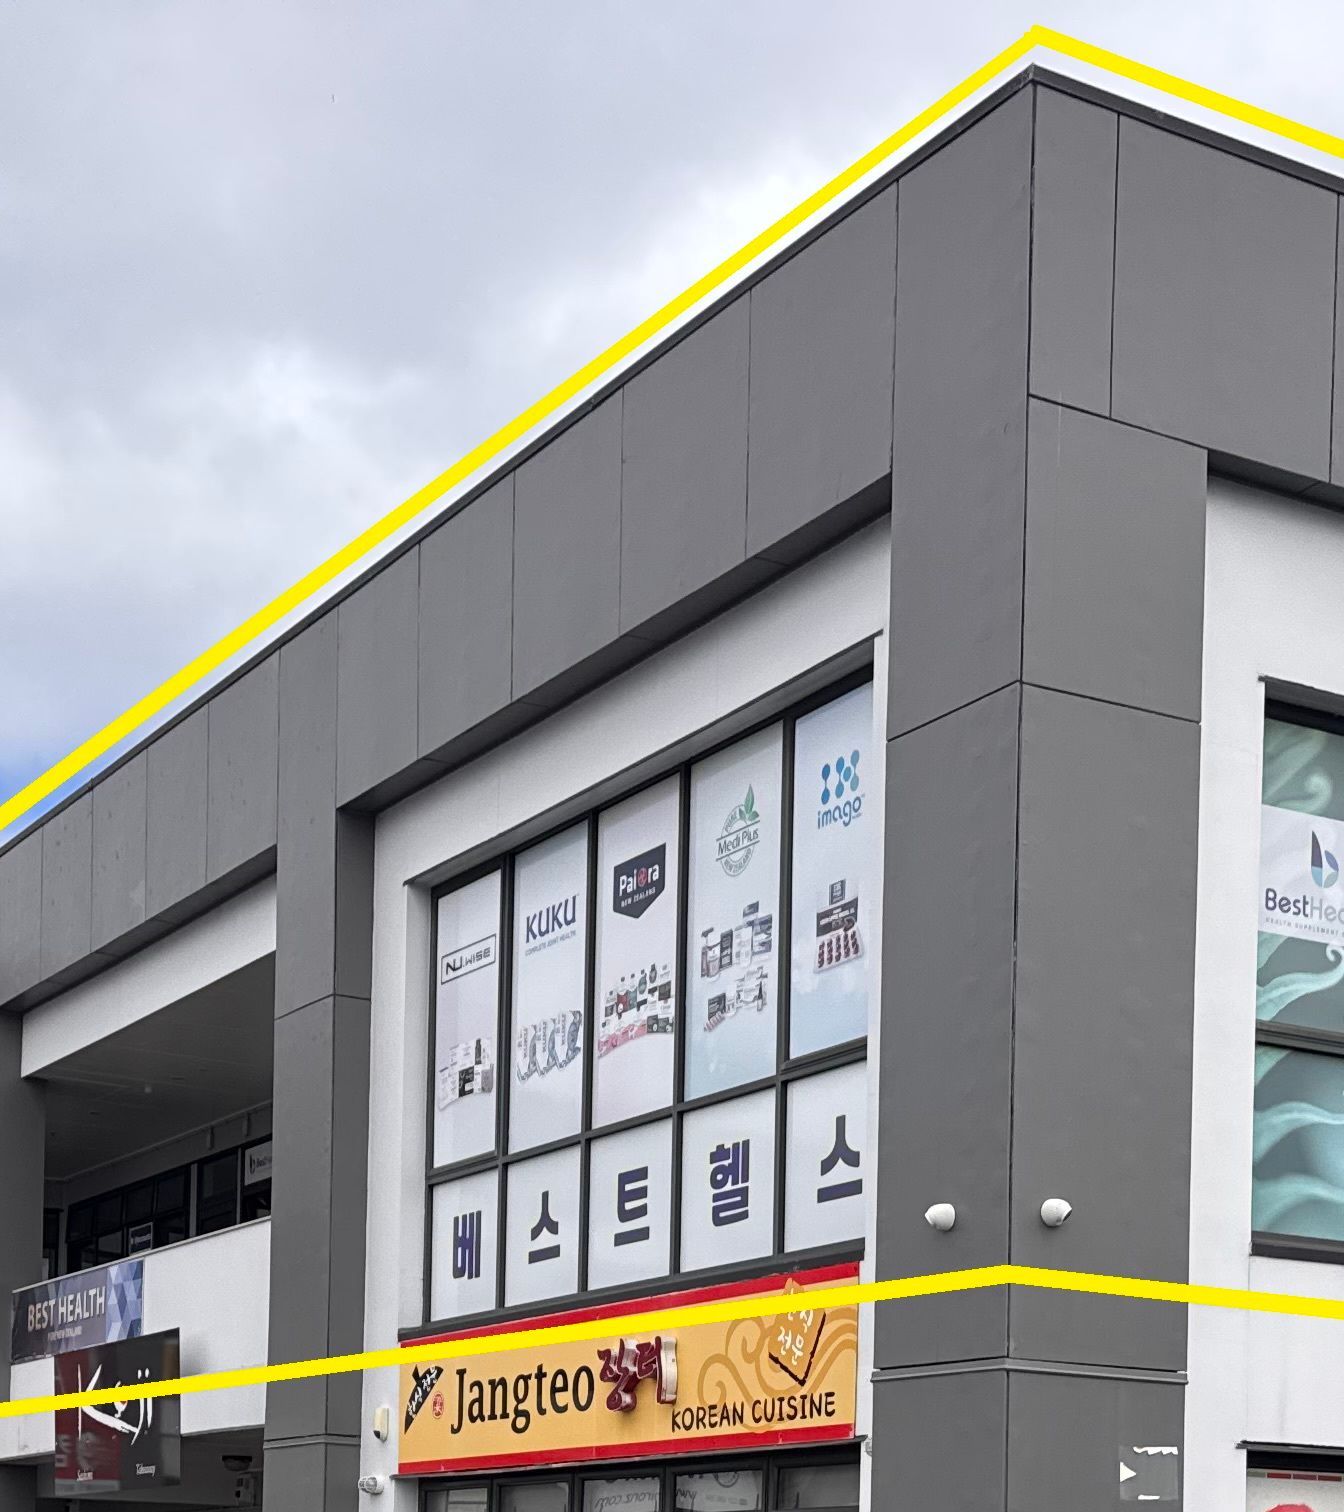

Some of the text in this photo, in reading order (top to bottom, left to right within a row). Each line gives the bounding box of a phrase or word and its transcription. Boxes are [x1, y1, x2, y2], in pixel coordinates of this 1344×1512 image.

[817, 796, 862, 829] imago
[717, 828, 759, 856] Medi Plus
[619, 864, 660, 897] Paiora
[525, 895, 577, 944] KUKU
[452, 1114, 863, 1280] 베스트헬스
[27, 1285, 106, 1333] BEST HEALTH
[597, 1336, 678, 1412] 장터
[450, 1363, 595, 1435] Jangteo
[671, 1391, 836, 1434] KOREAN CUISINE
